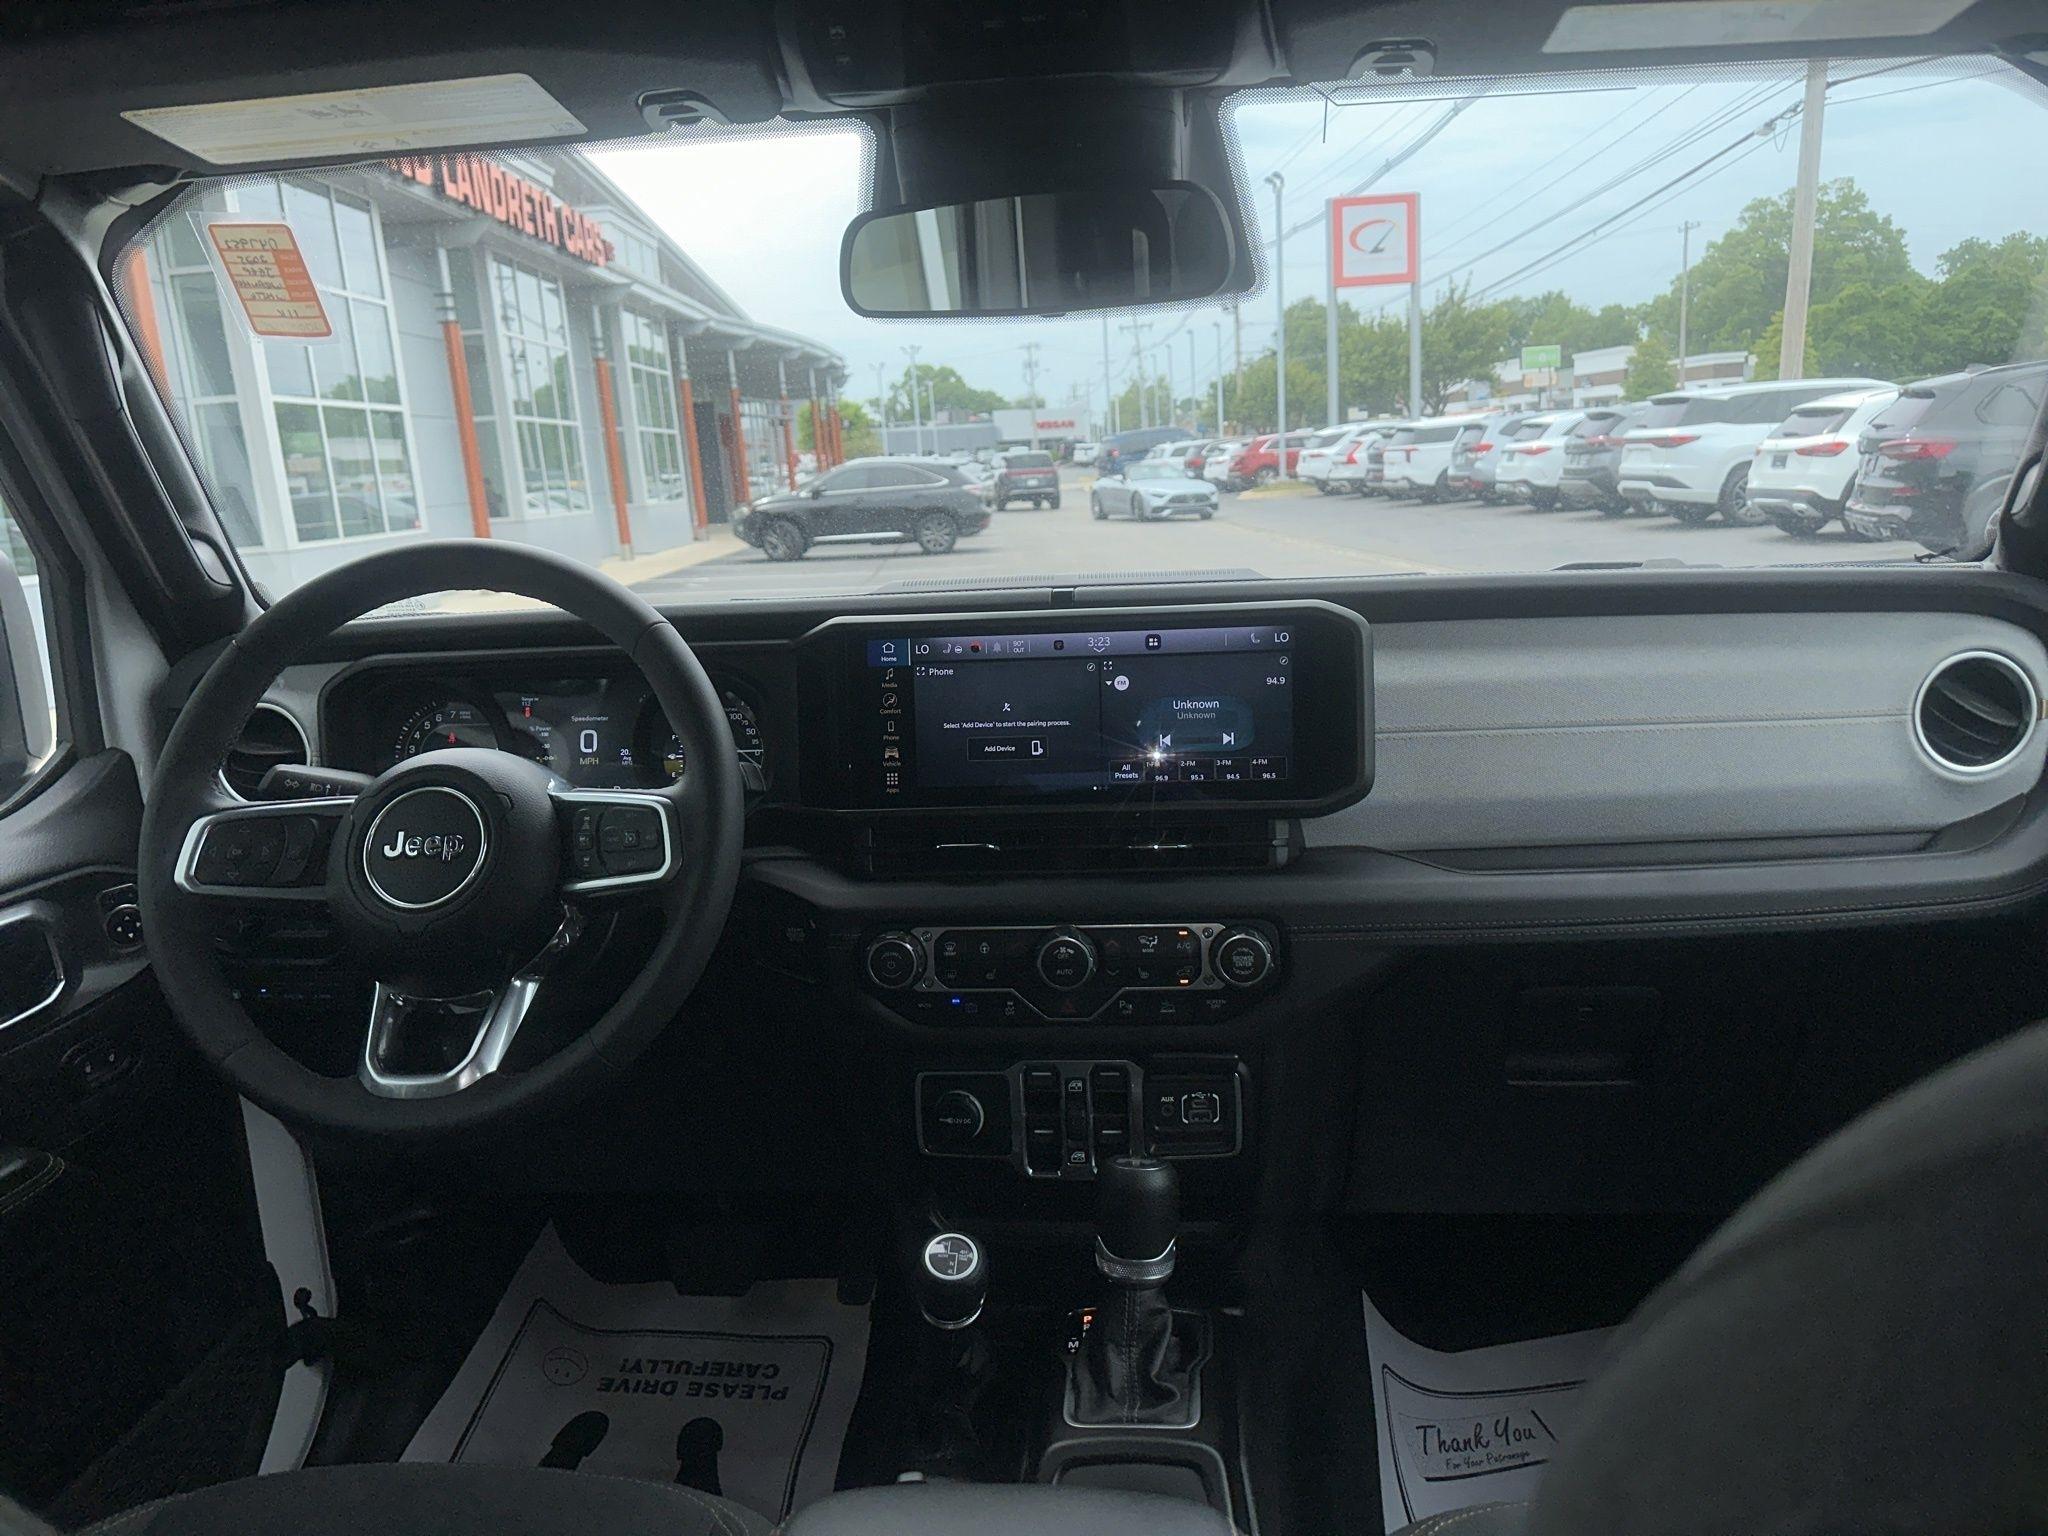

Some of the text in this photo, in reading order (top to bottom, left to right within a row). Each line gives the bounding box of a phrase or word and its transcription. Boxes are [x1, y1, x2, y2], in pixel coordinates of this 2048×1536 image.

[442, 155, 560, 247] LANDRETH
[561, 202, 608, 267] CARS
[1087, 637, 1111, 646] 3:23
[1274, 632, 1289, 643] LO
[915, 644, 930, 654] LO
[929, 668, 954, 676] Phone
[1266, 676, 1286, 685] 94.9
[1173, 700, 1220, 709] Unknown
[435, 713, 443, 722] 6
[450, 711, 457, 719] 7
[571, 715, 609, 723] Speedometer
[1177, 711, 1216, 720] Unknown
[424, 721, 431, 730] 5
[1026, 720, 1047, 728] pairing
[414, 731, 420, 739] 4
[579, 729, 598, 753] 0
[409, 745, 415, 753] 3
[579, 757, 599, 765] MPH
[1121, 763, 1131, 771] All
[1114, 772, 1139, 780] Presets
[383, 831, 465, 861] Jeep
[1176, 942, 1191, 950] A/C
[1083, 1315, 1093, 1323] P
[1068, 1341, 1080, 1349] M
[618, 1357, 781, 1380] CAREFULLY!
[596, 1376, 790, 1400] PLEASE DRIVE
[1415, 1416, 1536, 1456] Thank You
[1445, 1458, 1462, 1470] For
[1463, 1456, 1485, 1469] Your
